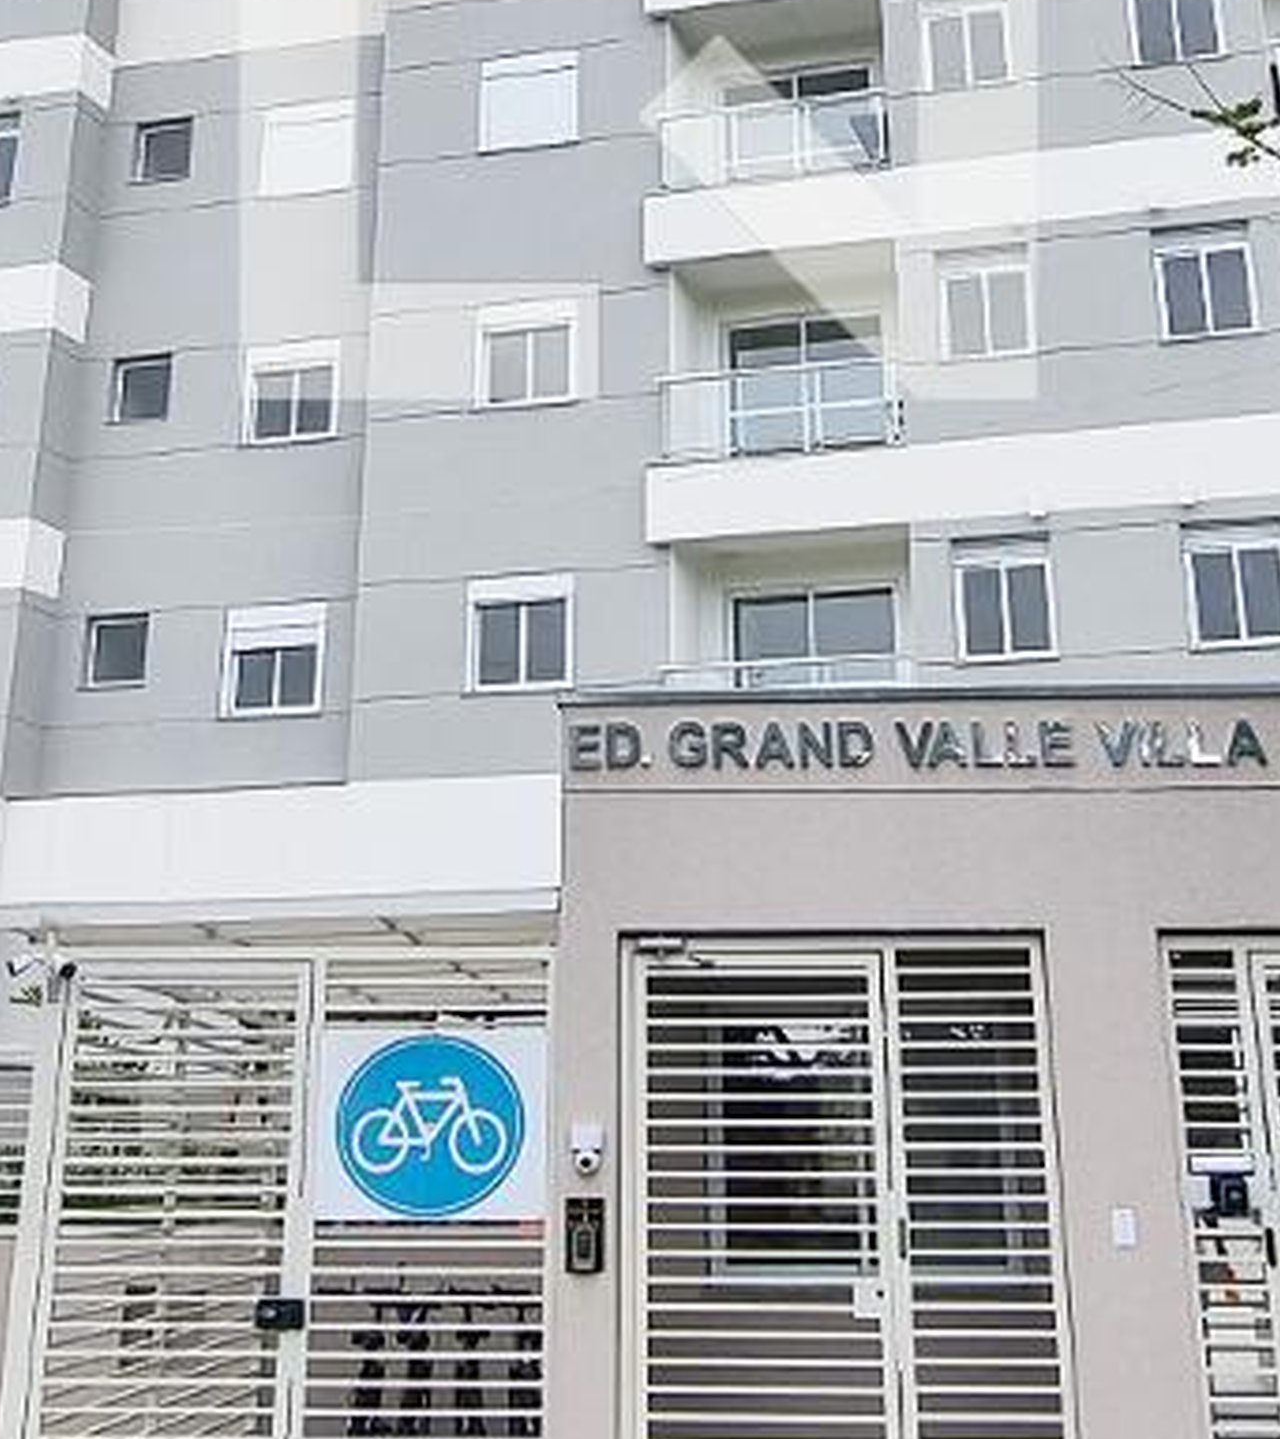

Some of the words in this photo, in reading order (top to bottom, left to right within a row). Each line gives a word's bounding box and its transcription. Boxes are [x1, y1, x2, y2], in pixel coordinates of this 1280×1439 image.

[570, 722, 652, 770] ED.
[670, 721, 873, 769] GRAND
[894, 720, 1075, 768] VALLE
[1096, 719, 1268, 768] VILLA
